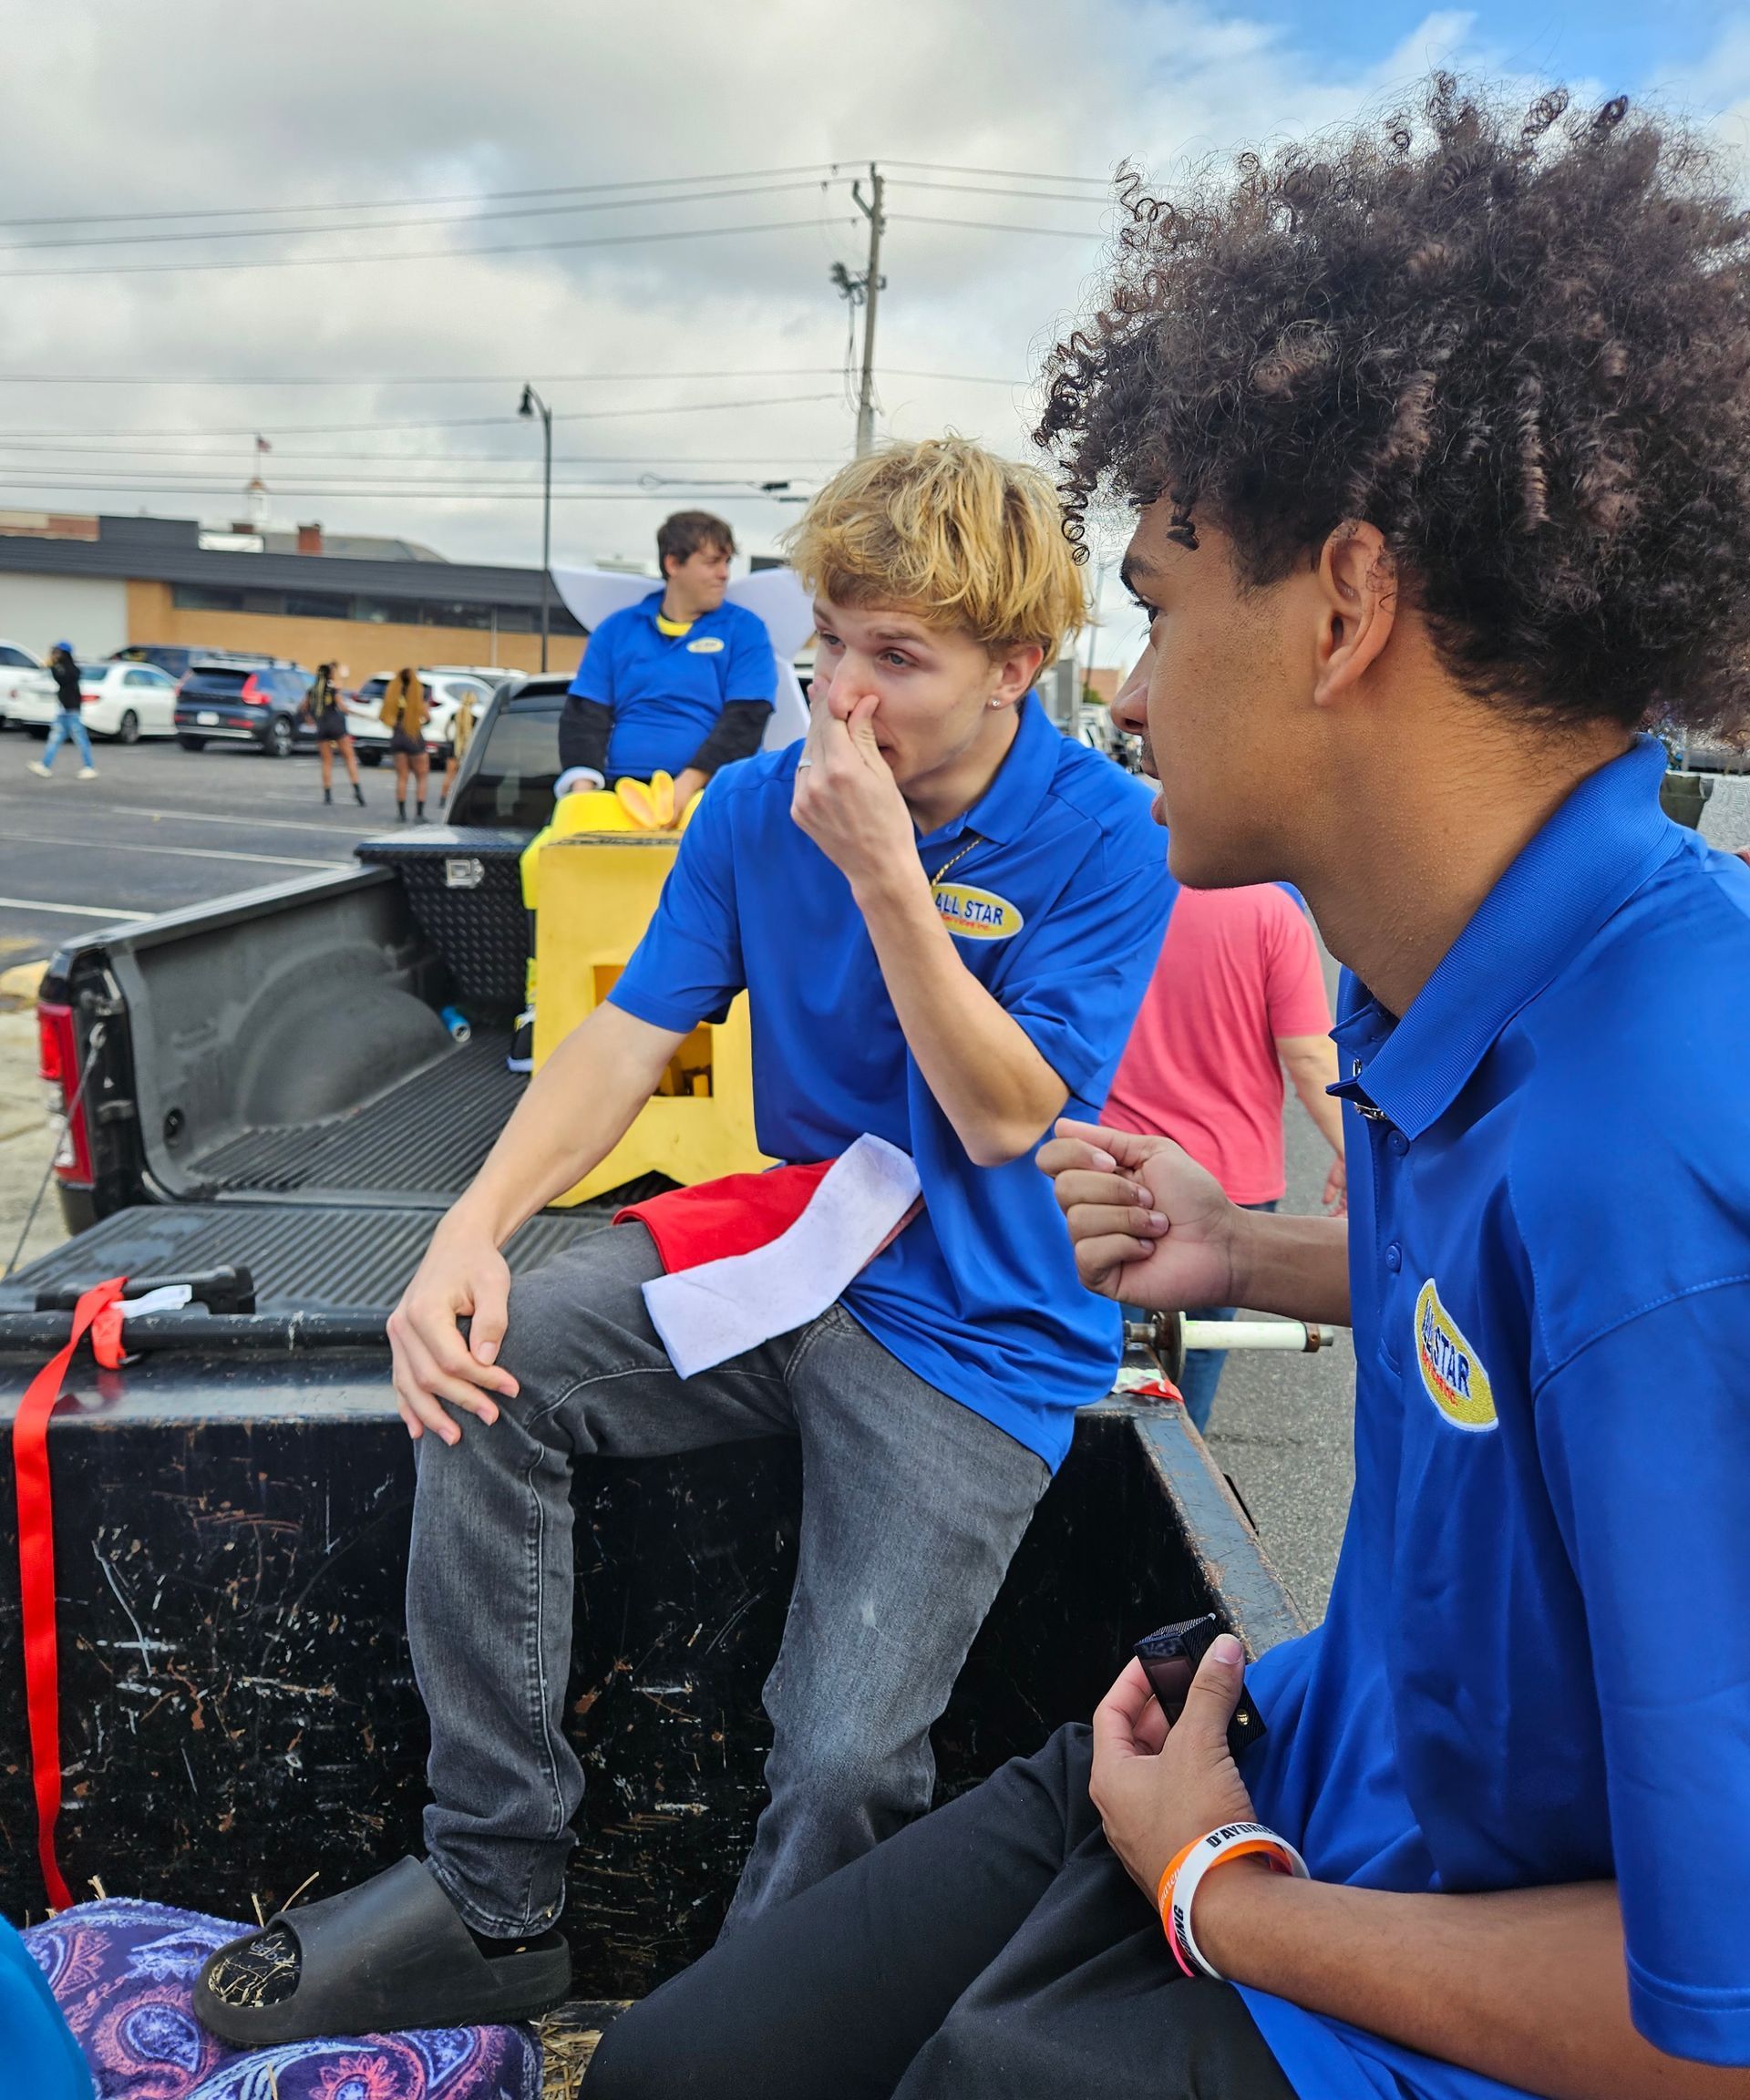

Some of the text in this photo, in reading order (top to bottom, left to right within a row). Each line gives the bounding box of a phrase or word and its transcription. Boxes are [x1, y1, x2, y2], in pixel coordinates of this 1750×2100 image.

[935, 892, 959, 915] ALL
[964, 900, 1004, 926] STAR
[1433, 1325, 1471, 1400] STAR
